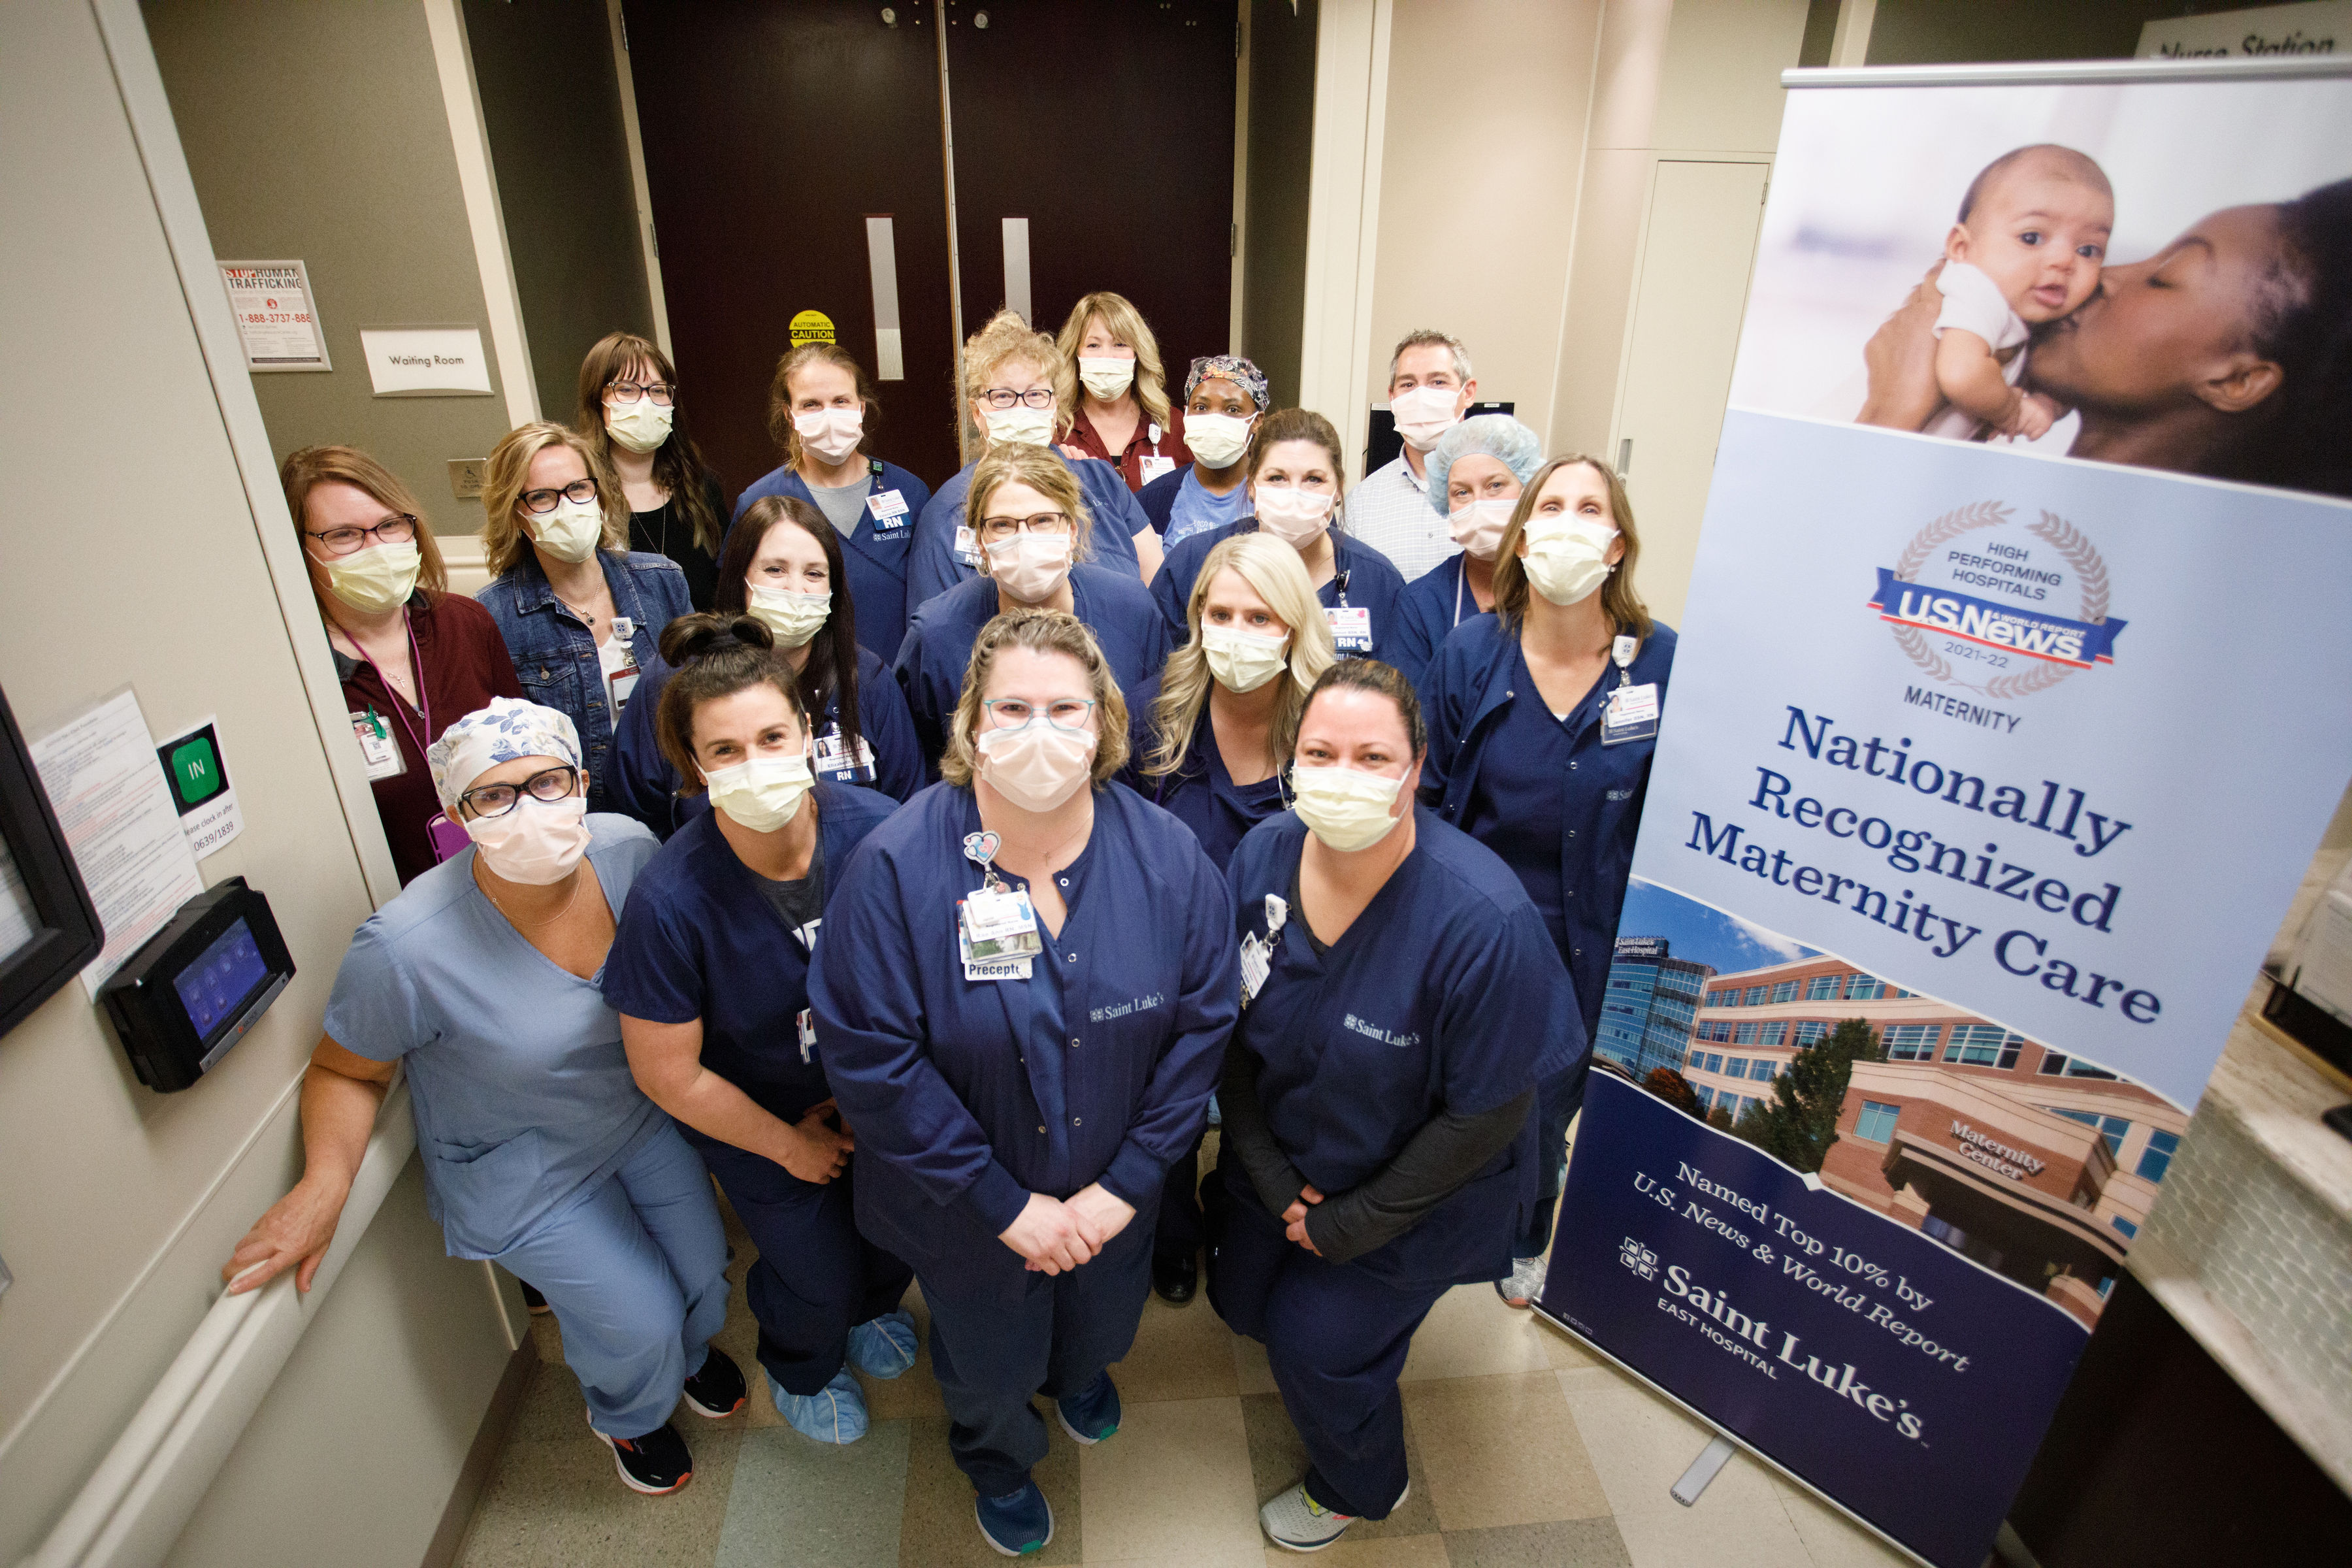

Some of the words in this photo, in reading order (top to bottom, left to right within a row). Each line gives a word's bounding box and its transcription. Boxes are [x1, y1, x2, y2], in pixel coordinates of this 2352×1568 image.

[791, 330, 834, 338] CAUTION
[389, 355, 431, 368] Waiting
[434, 355, 465, 365] Room
[881, 531, 900, 541] Saint
[883, 516, 904, 529] RN
[965, 553, 983, 565] RN
[1986, 542, 2029, 562] HIGH
[1947, 550, 2062, 587] PERFORMING
[1952, 568, 2047, 602] HOSPITALS
[2001, 613, 2038, 629] WORLD
[2040, 622, 2086, 638] REPORT
[1337, 637, 1356, 647] RN
[1944, 642, 2009, 668] 2021-22
[1903, 685, 2022, 734] MATERNITY
[188, 759, 206, 781] IN
[836, 770, 852, 781] RN
[1777, 704, 2132, 858] Nationally
[184, 824, 200, 836] lease
[201, 815, 216, 828] clock
[216, 811, 223, 820] in
[223, 803, 234, 815] after
[193, 821, 235, 852] 0639/1839
[1748, 766, 2121, 933] Recognized
[1684, 810, 1982, 958] Maternity
[1993, 928, 2161, 1024] Care
[1630, 945, 1658, 956] Hospital
[969, 964, 1019, 976] Precept
[1104, 1003, 1133, 1020] Saint
[1134, 992, 1164, 1012] Luke's
[1355, 1019, 1384, 1041] Saint
[1384, 1030, 1420, 1047] Luke's
[1949, 1119, 2046, 1173] Maternity
[1959, 1141, 2024, 1180] Center
[1675, 1160, 1769, 1224] Named
[1772, 1212, 1825, 1256] Top
[1829, 1245, 1891, 1289] 10%
[1896, 1275, 1935, 1312] by
[1633, 1171, 1676, 1212] U.S.
[1680, 1201, 1750, 1249] News
[1752, 1243, 1775, 1264] &
[1782, 1253, 1868, 1313] World
[1864, 1301, 1970, 1373] Report
[1657, 1296, 1699, 1328] EAST
[1699, 1322, 1778, 1380] HOSPITAL
[1663, 1264, 1771, 1350] Saint
[1776, 1330, 1924, 1440] Luke's
